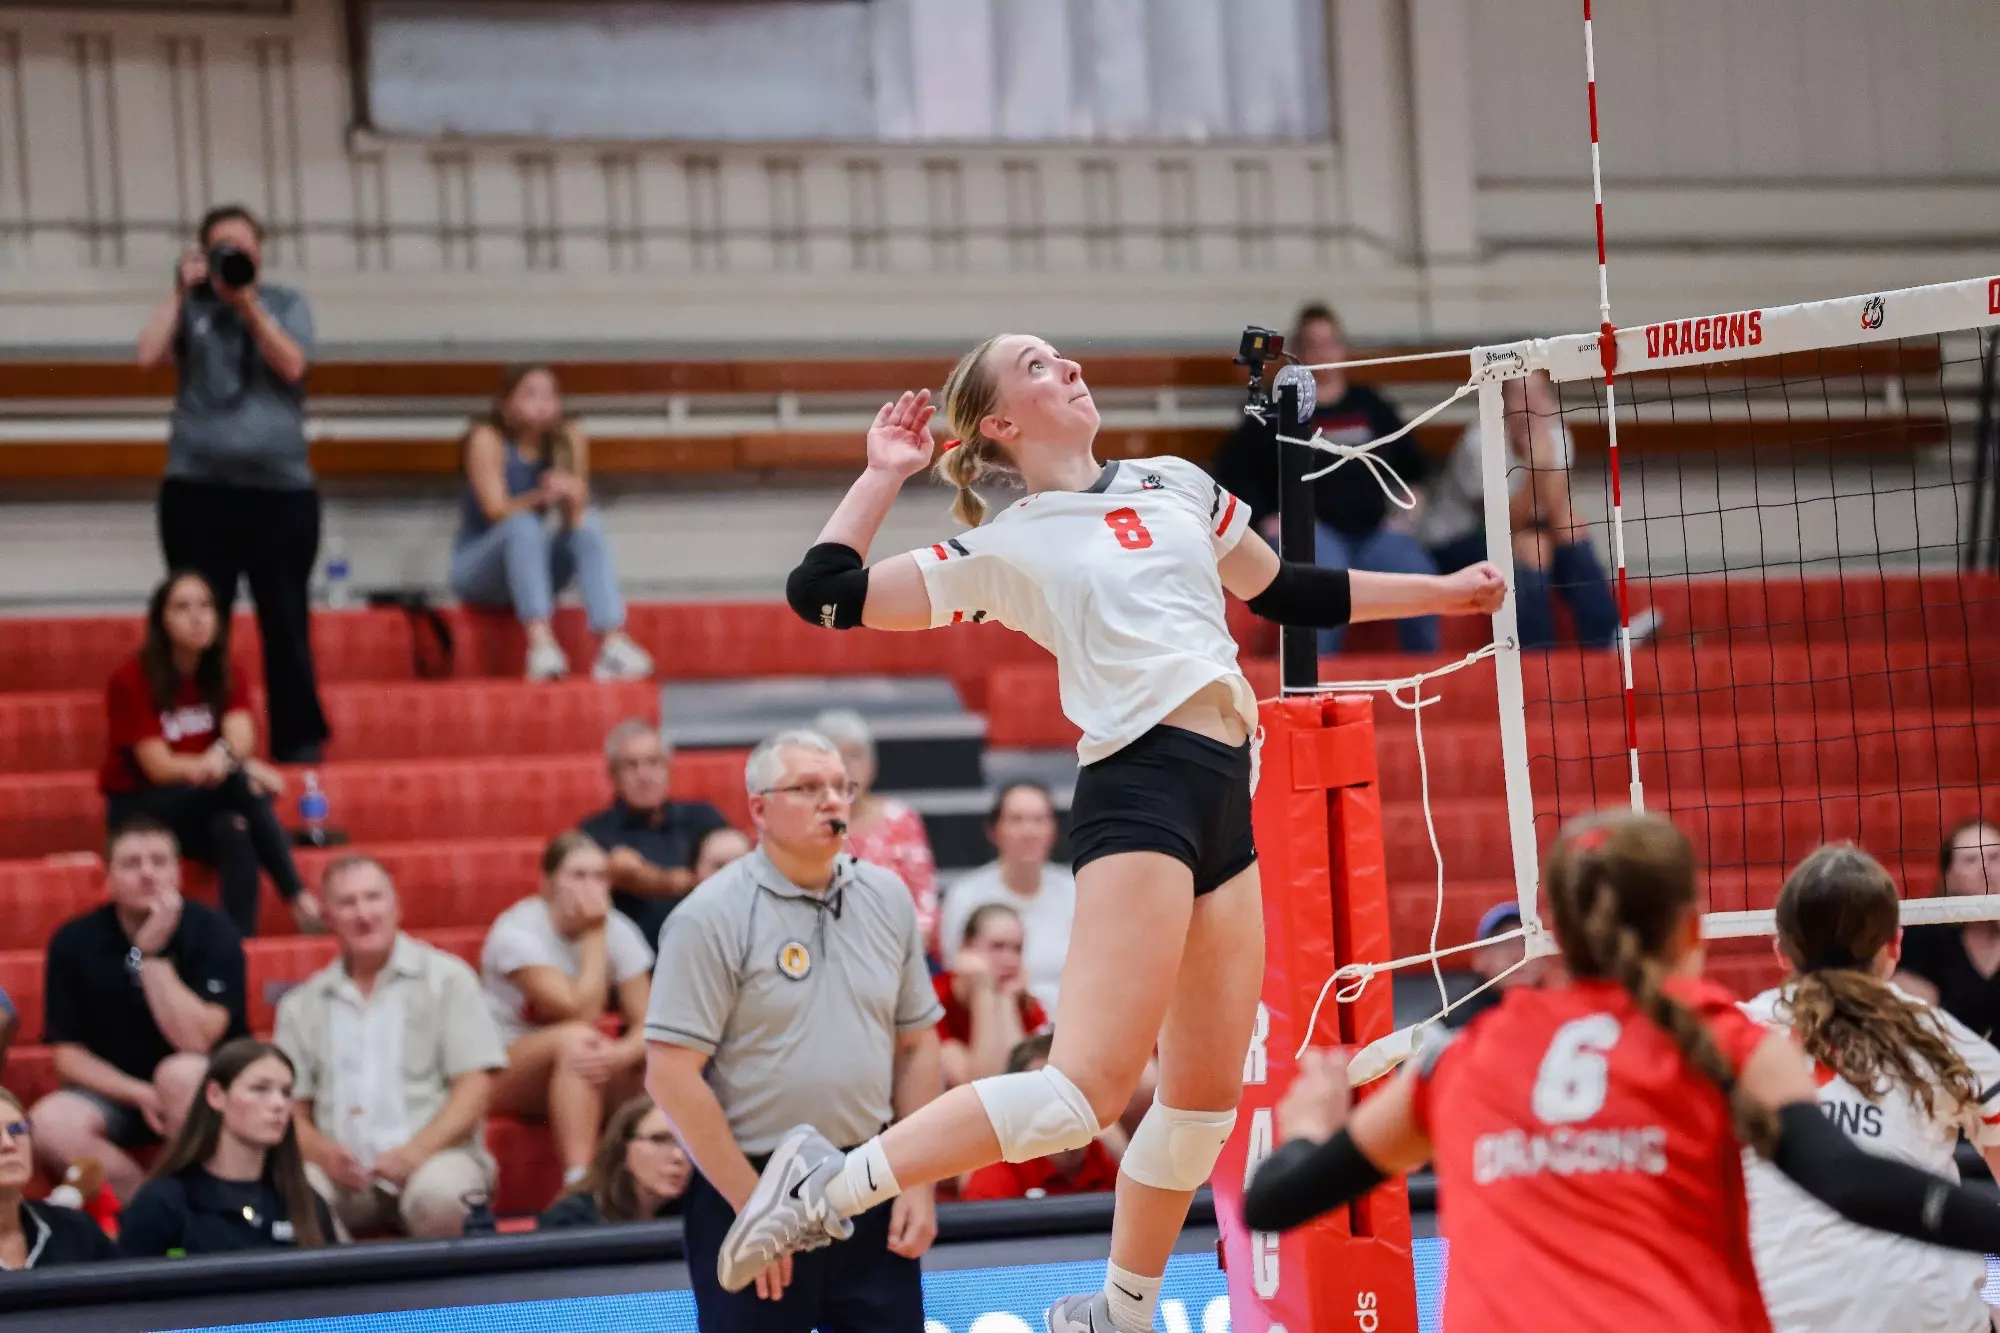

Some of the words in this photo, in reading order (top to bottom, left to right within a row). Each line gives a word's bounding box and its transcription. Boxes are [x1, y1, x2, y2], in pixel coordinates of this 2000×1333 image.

[1645, 310, 1762, 359] DRAGONS
[1103, 506, 1154, 550] 8
[1531, 1012, 1622, 1125] 6
